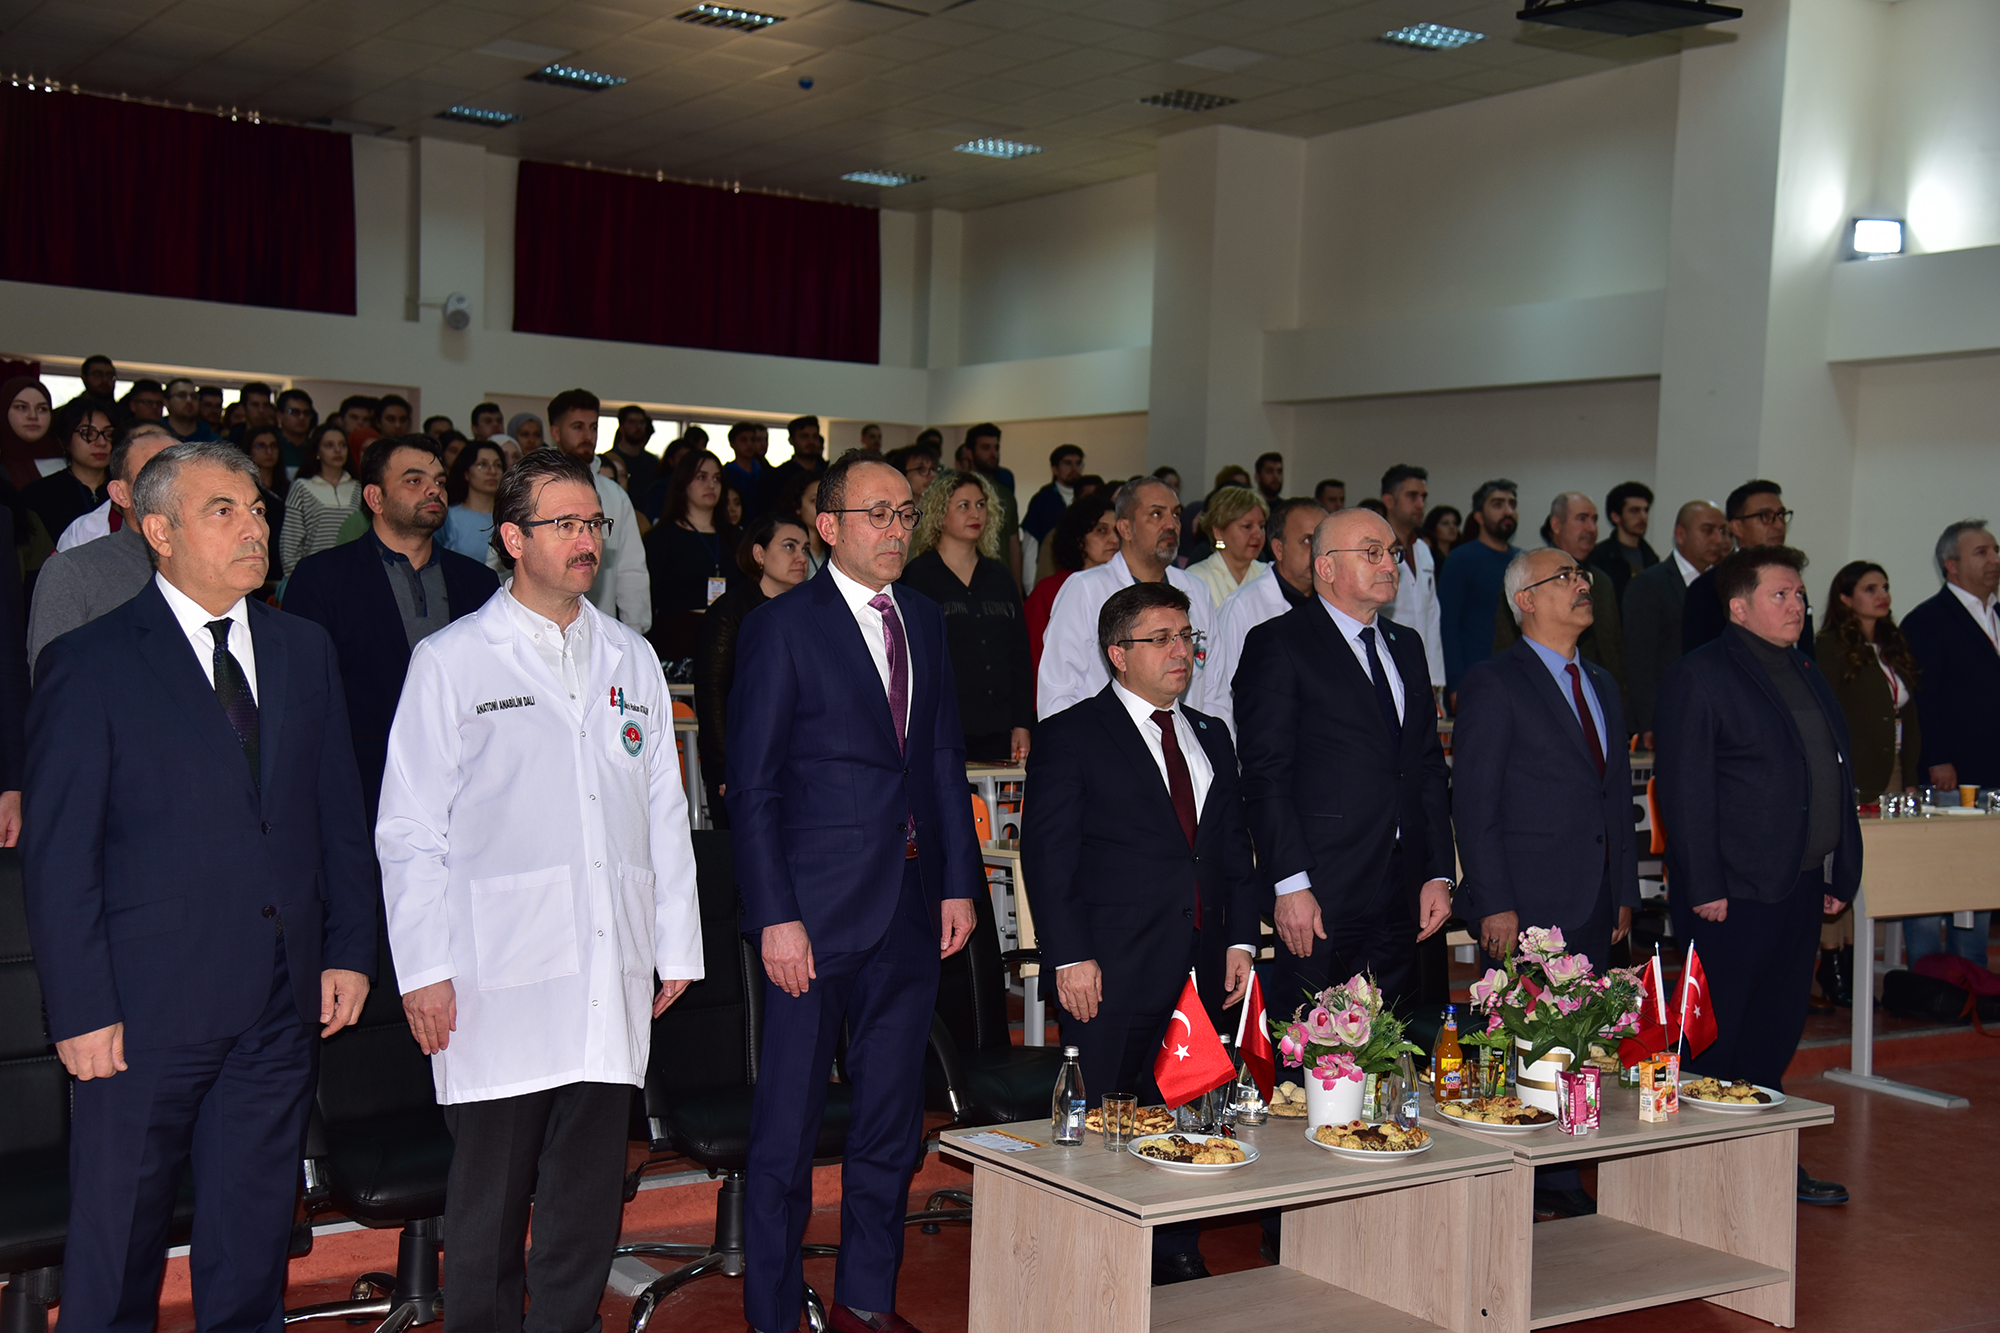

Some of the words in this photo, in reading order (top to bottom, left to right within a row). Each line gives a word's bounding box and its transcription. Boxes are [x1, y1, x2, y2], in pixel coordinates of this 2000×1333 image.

[476, 699, 499, 715] ANATOMİ
[499, 695, 523, 710] ANABİLİM
[523, 696, 535, 706] DALI
